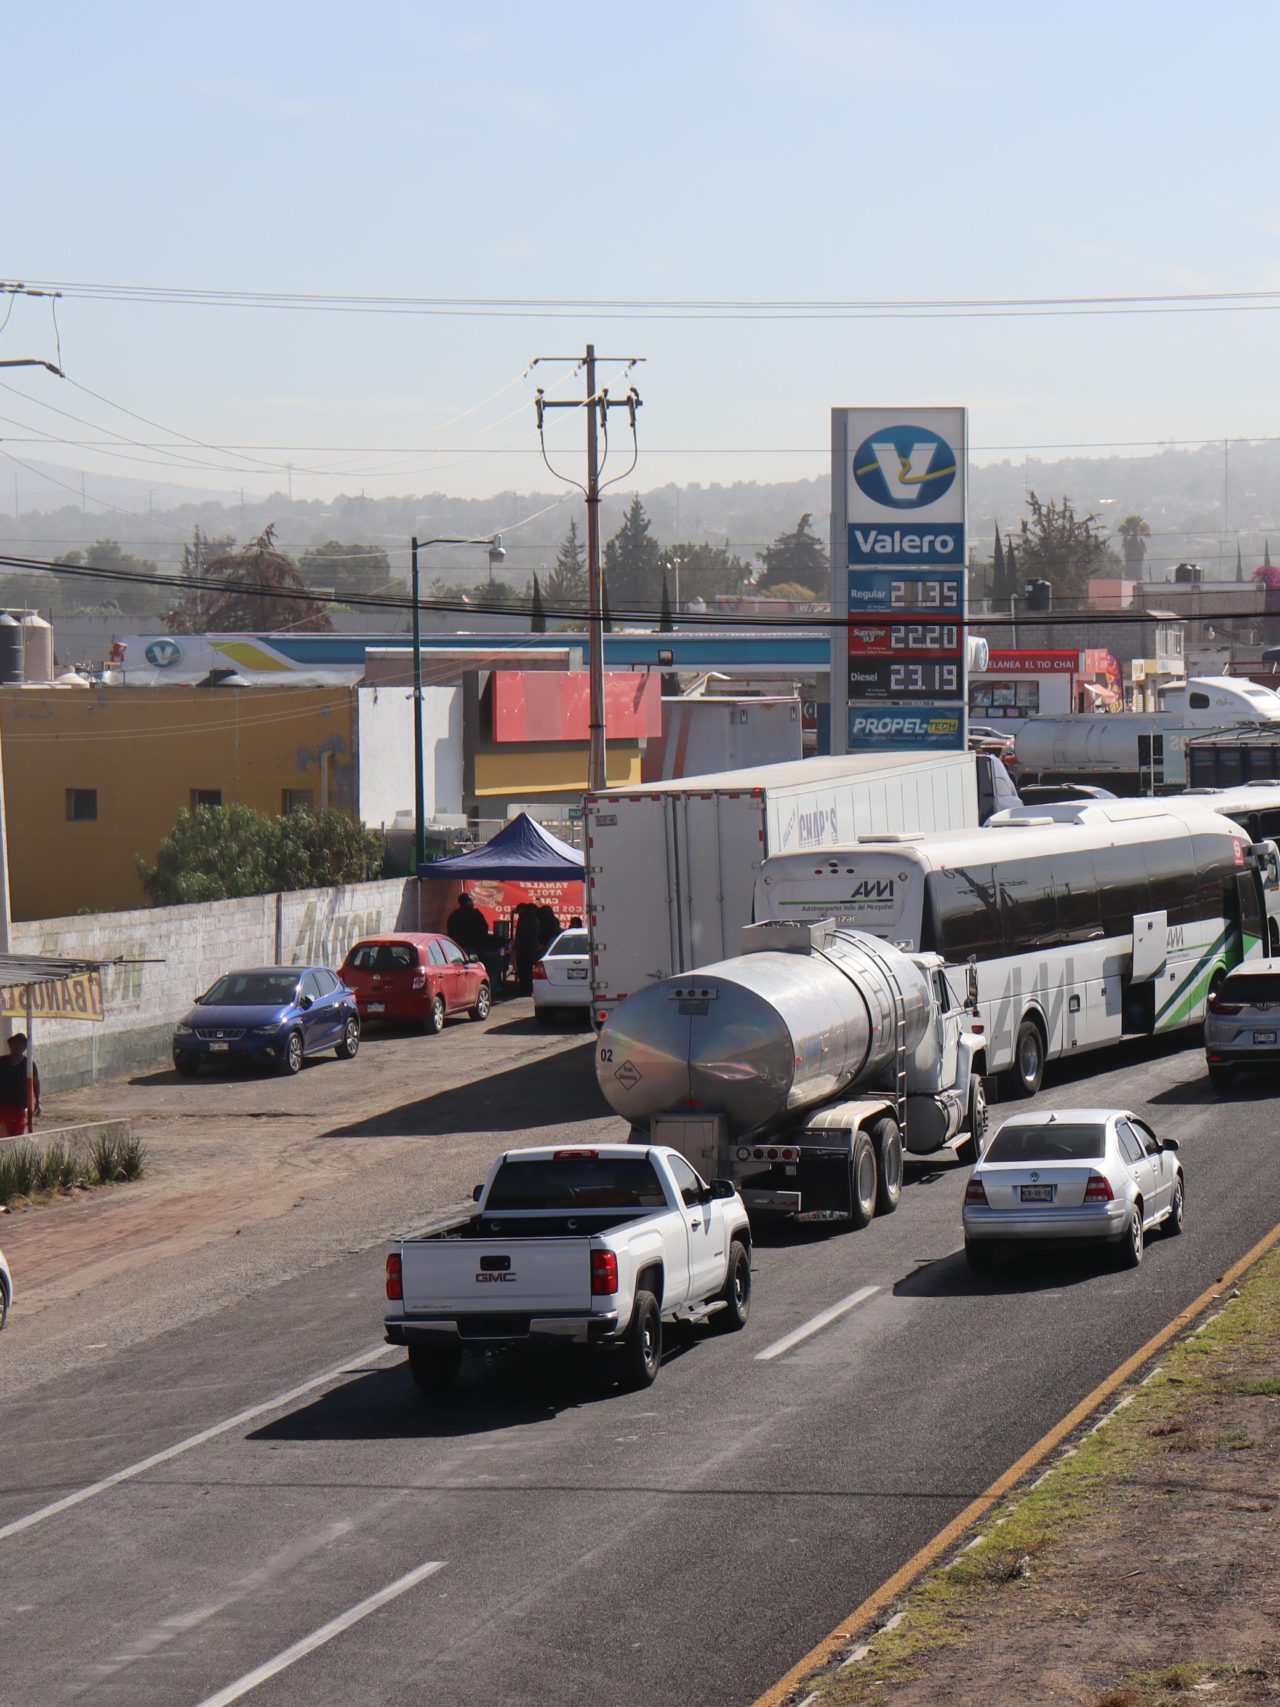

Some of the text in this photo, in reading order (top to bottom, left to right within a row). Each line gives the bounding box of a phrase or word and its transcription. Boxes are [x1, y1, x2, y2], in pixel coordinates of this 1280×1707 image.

[854, 530, 955, 553] Valero
[851, 589, 887, 599] Regular
[988, 660, 1021, 669] ELANEA
[1025, 661, 1035, 669] EL
[1037, 661, 1051, 669] TIO
[850, 672, 878, 681] Diesel
[600, 1048, 613, 1062] 02
[475, 1272, 517, 1283] GMC
